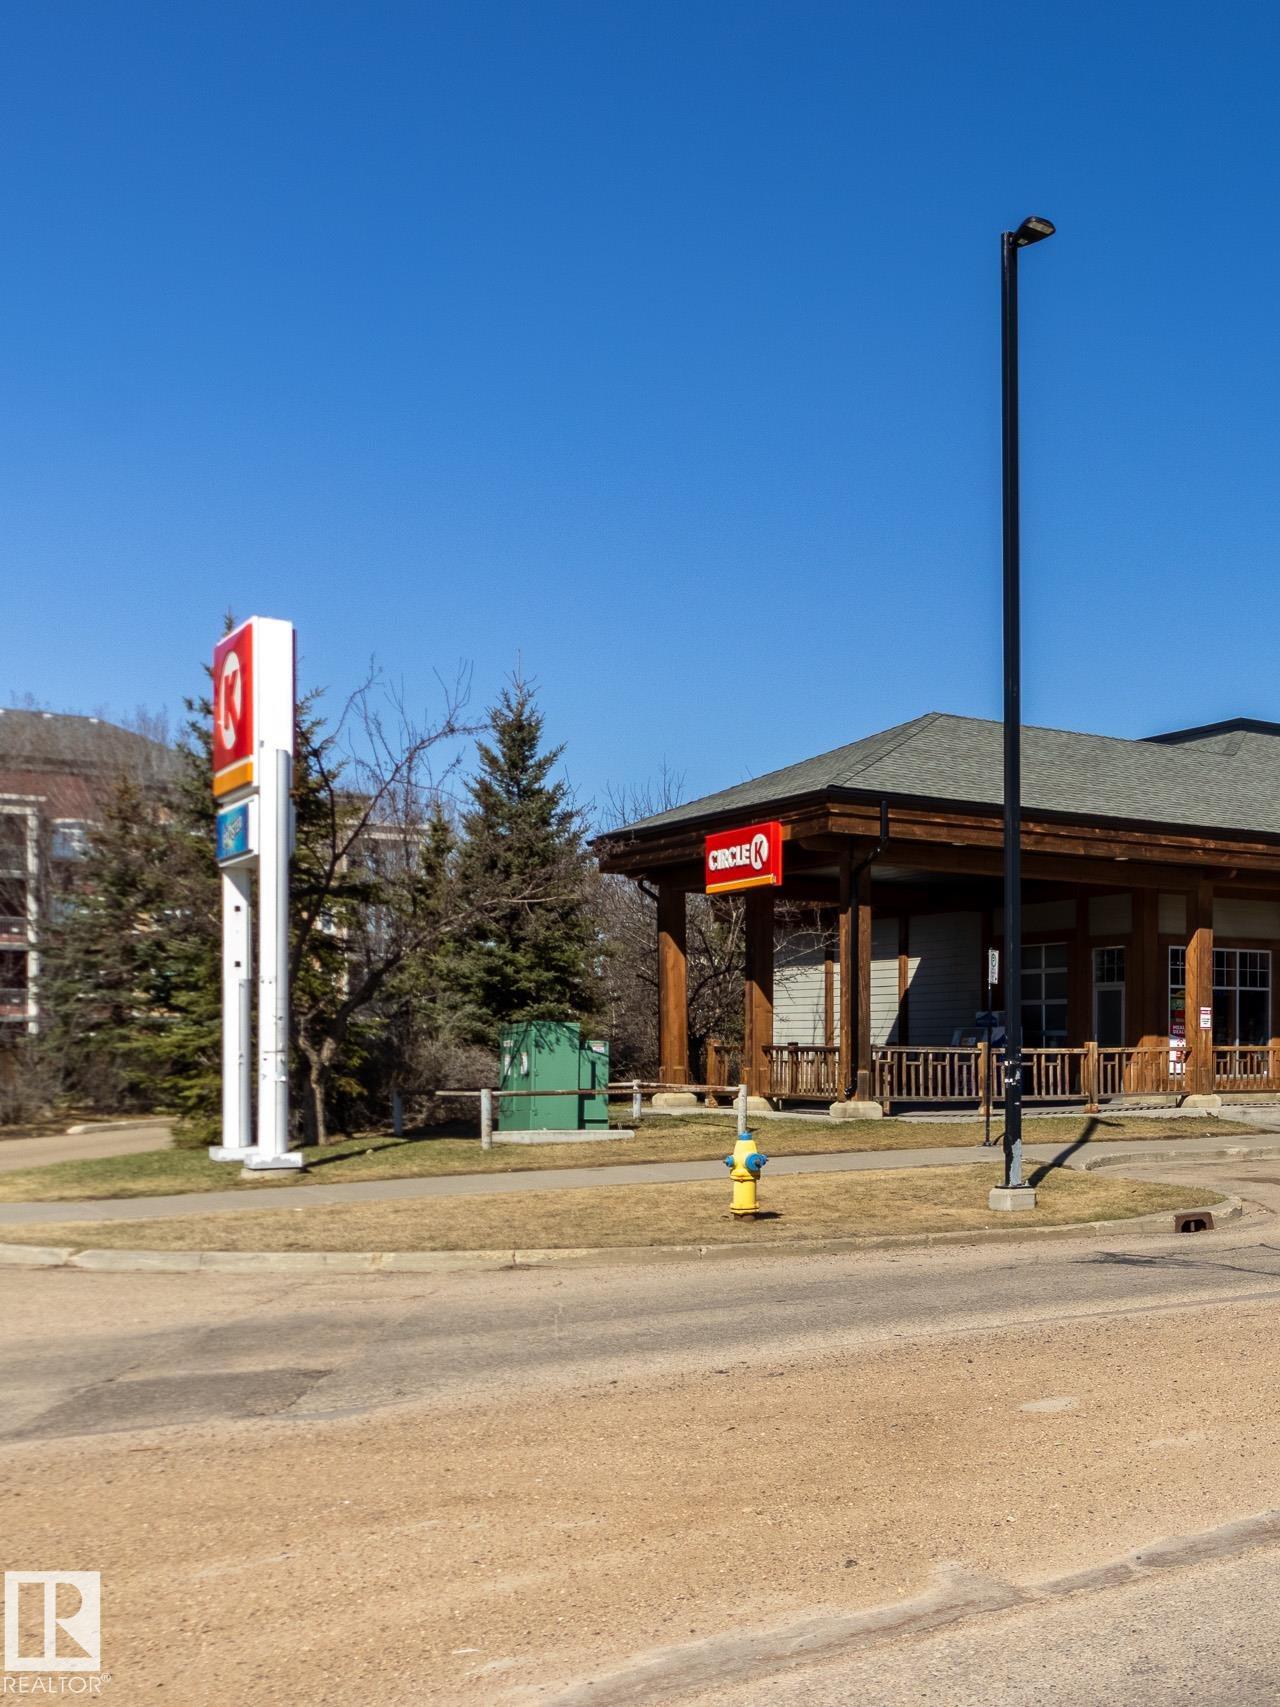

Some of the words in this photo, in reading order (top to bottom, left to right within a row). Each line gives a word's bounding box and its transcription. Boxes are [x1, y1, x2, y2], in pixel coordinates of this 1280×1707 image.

[220, 652, 241, 749] K
[709, 844, 751, 871] CIRCLE
[751, 834, 768, 869] K
